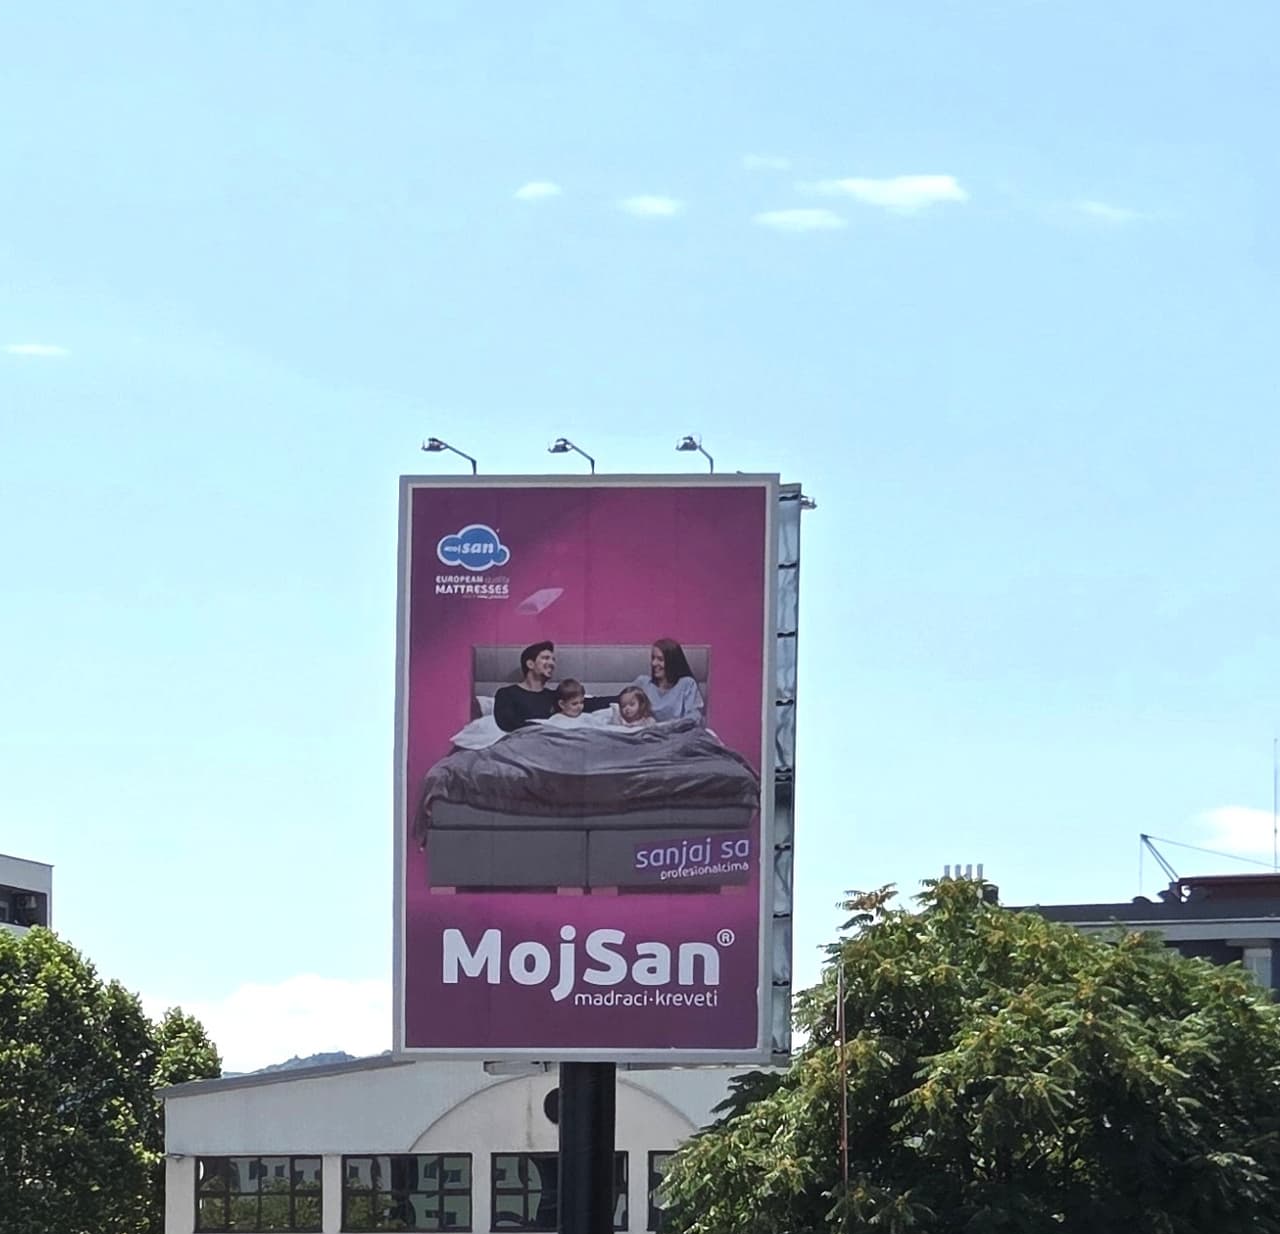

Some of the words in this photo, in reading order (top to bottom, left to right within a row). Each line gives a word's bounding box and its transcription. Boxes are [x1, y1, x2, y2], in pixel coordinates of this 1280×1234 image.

[436, 575, 483, 583] EUROPEAN
[435, 584, 509, 594] MATTRESSES
[635, 837, 711, 868] sanjaj
[721, 839, 749, 858] sa
[660, 862, 749, 880] profesionalcima
